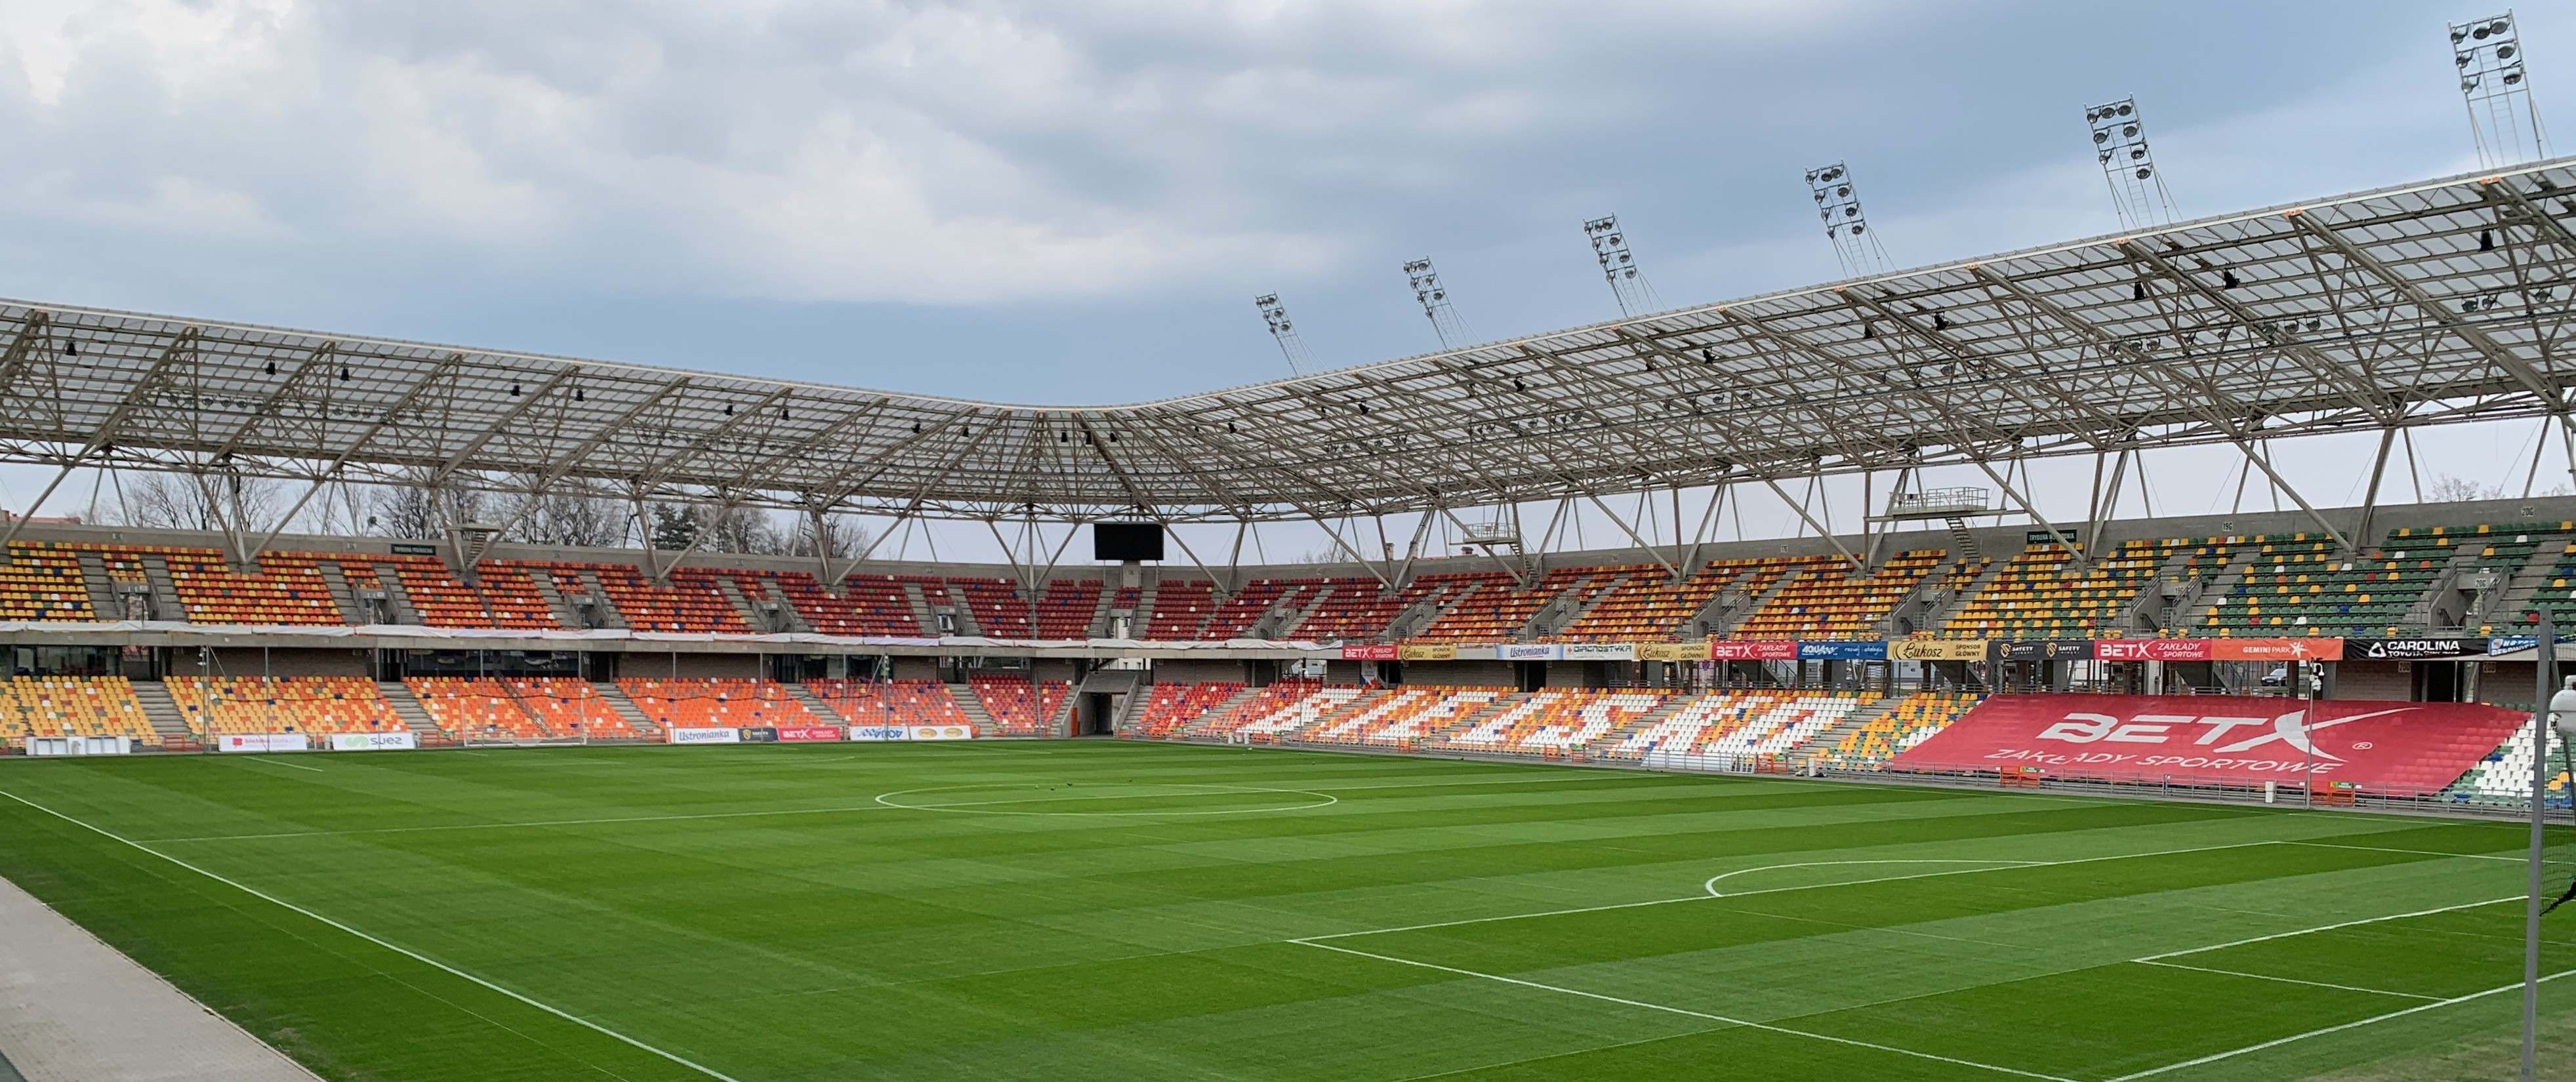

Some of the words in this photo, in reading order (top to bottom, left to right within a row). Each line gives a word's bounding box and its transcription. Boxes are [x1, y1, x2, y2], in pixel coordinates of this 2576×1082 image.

[1510, 646, 1549, 658] Ustronianka
[1716, 643, 1757, 658] BETX
[2100, 641, 2157, 658] BETX
[2157, 643, 2201, 651] ZAKŁADY
[2387, 641, 2461, 651] CAROLINA
[1345, 647, 1372, 659] BETX
[370, 736, 403, 746] suez
[679, 730, 730, 741] Ustronianka
[2035, 707, 2424, 763] BETX
[1983, 748, 2137, 765] ZAKŁADY
[2136, 755, 2343, 774] SPORTOWE
